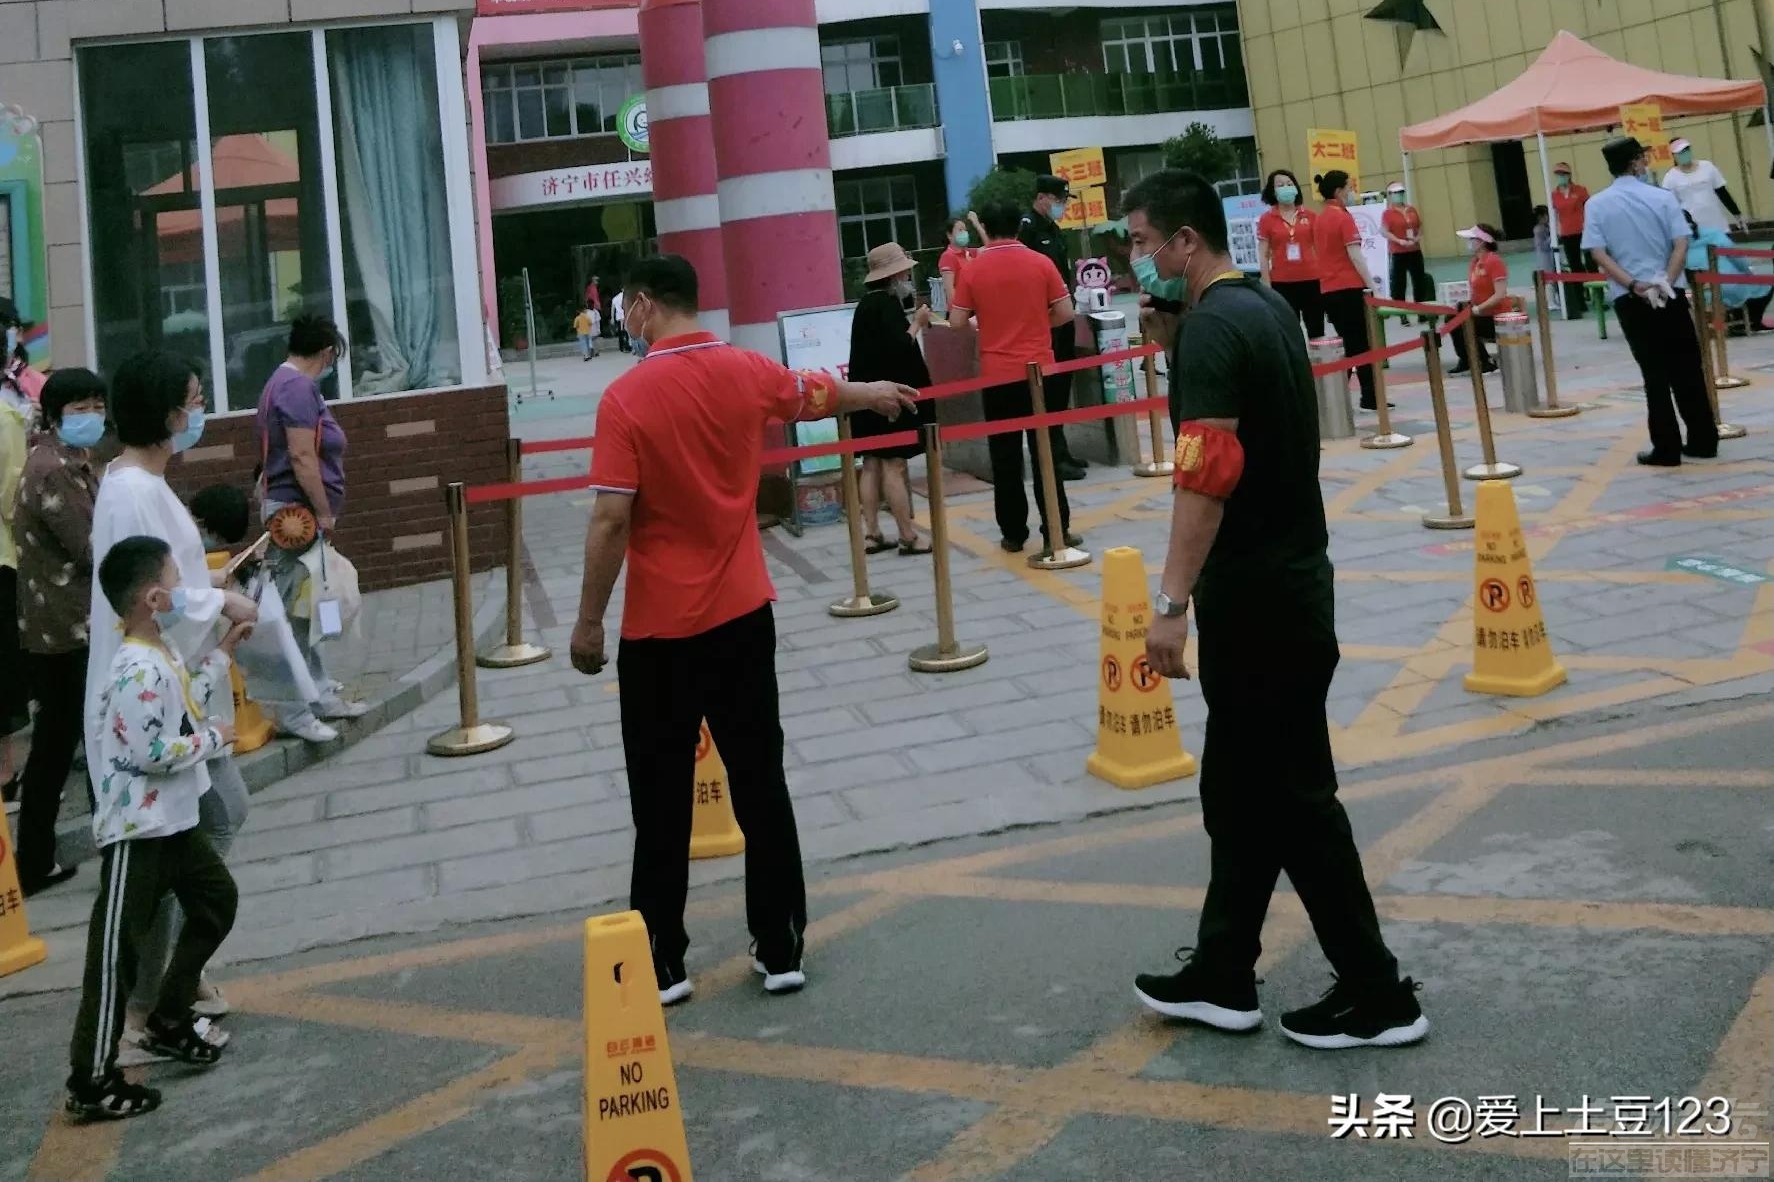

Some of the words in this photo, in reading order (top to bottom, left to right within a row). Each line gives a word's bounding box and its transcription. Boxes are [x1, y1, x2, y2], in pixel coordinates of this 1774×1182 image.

[1312, 141, 1355, 160] 大二班
[1476, 626, 1520, 650] 请勿泊车
[1129, 706, 1175, 736] 请勿泊车
[697, 780, 723, 804] 泊车
[620, 1062, 643, 1086] NO
[599, 1088, 670, 1121] PARKING
